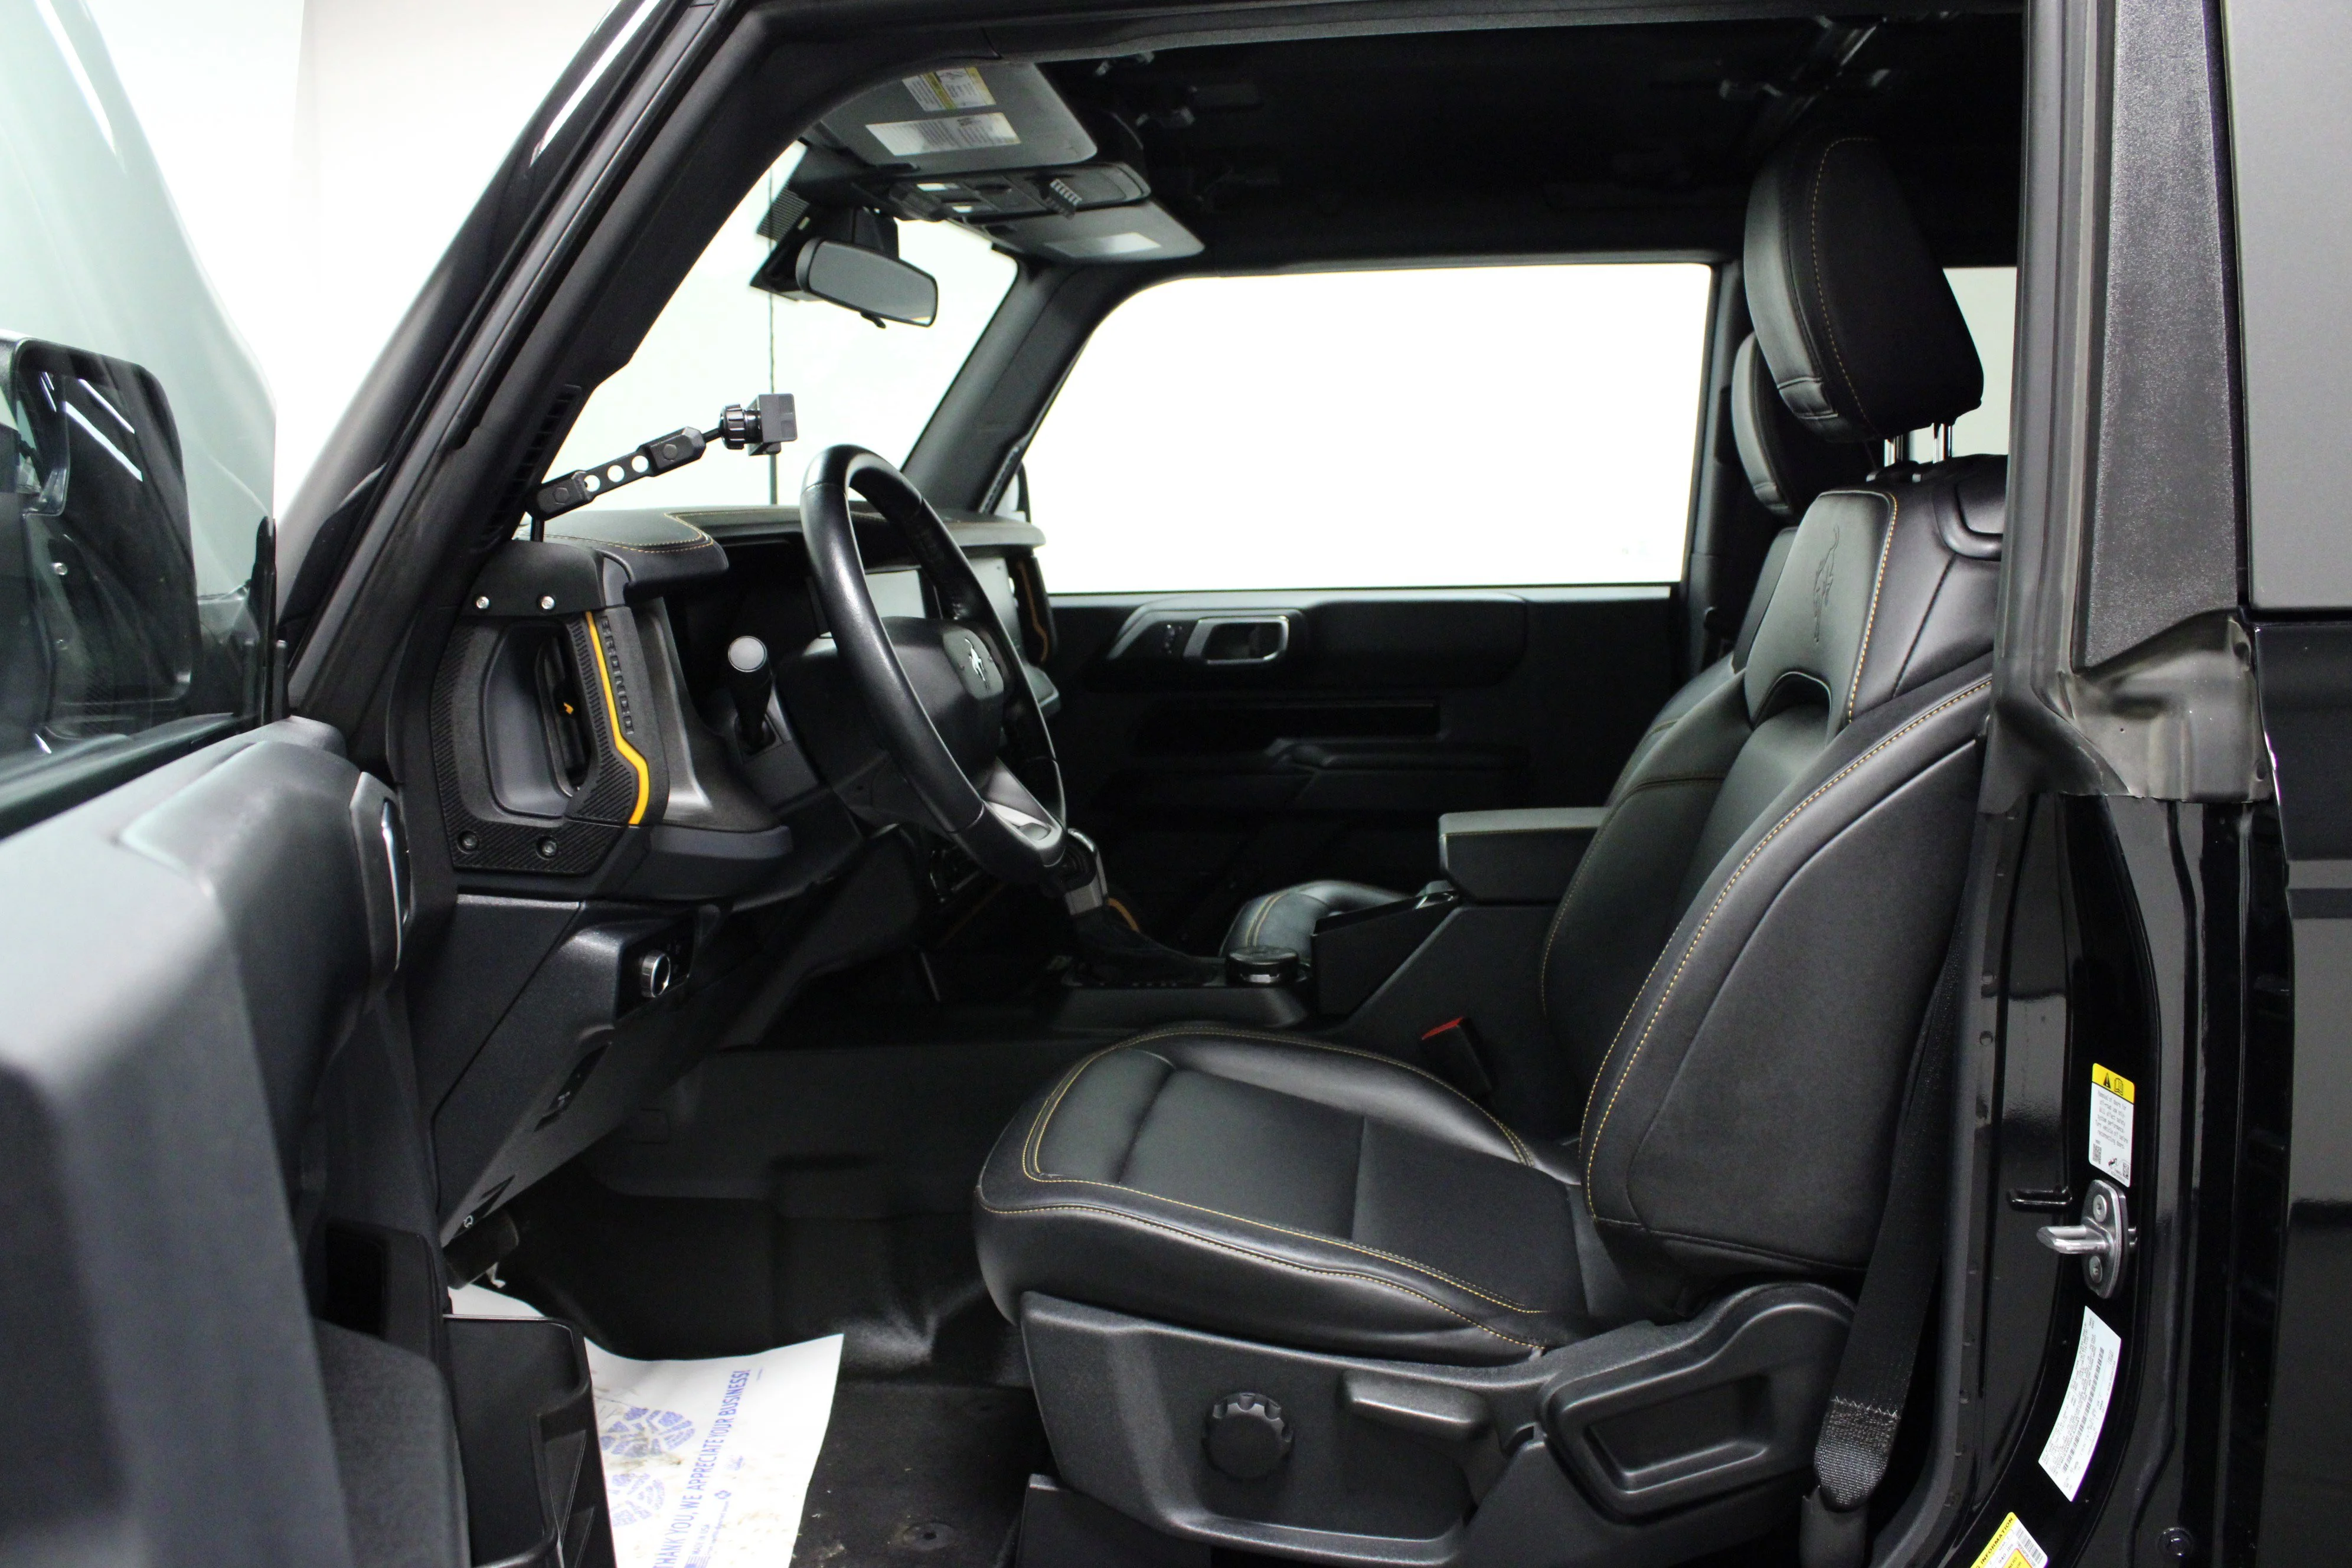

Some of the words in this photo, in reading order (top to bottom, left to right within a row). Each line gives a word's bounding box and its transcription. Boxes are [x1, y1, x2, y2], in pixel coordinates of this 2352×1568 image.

[601, 616, 634, 734] BRONCO
[717, 1369, 750, 1416] BUSINESS!
[707, 1417, 734, 1438] YOUR
[685, 1439, 724, 1491] APPRECIATE
[665, 1512, 699, 1536] YOU,
[679, 1494, 703, 1510] WE
[1981, 1517, 2013, 1564] INFORMATION
